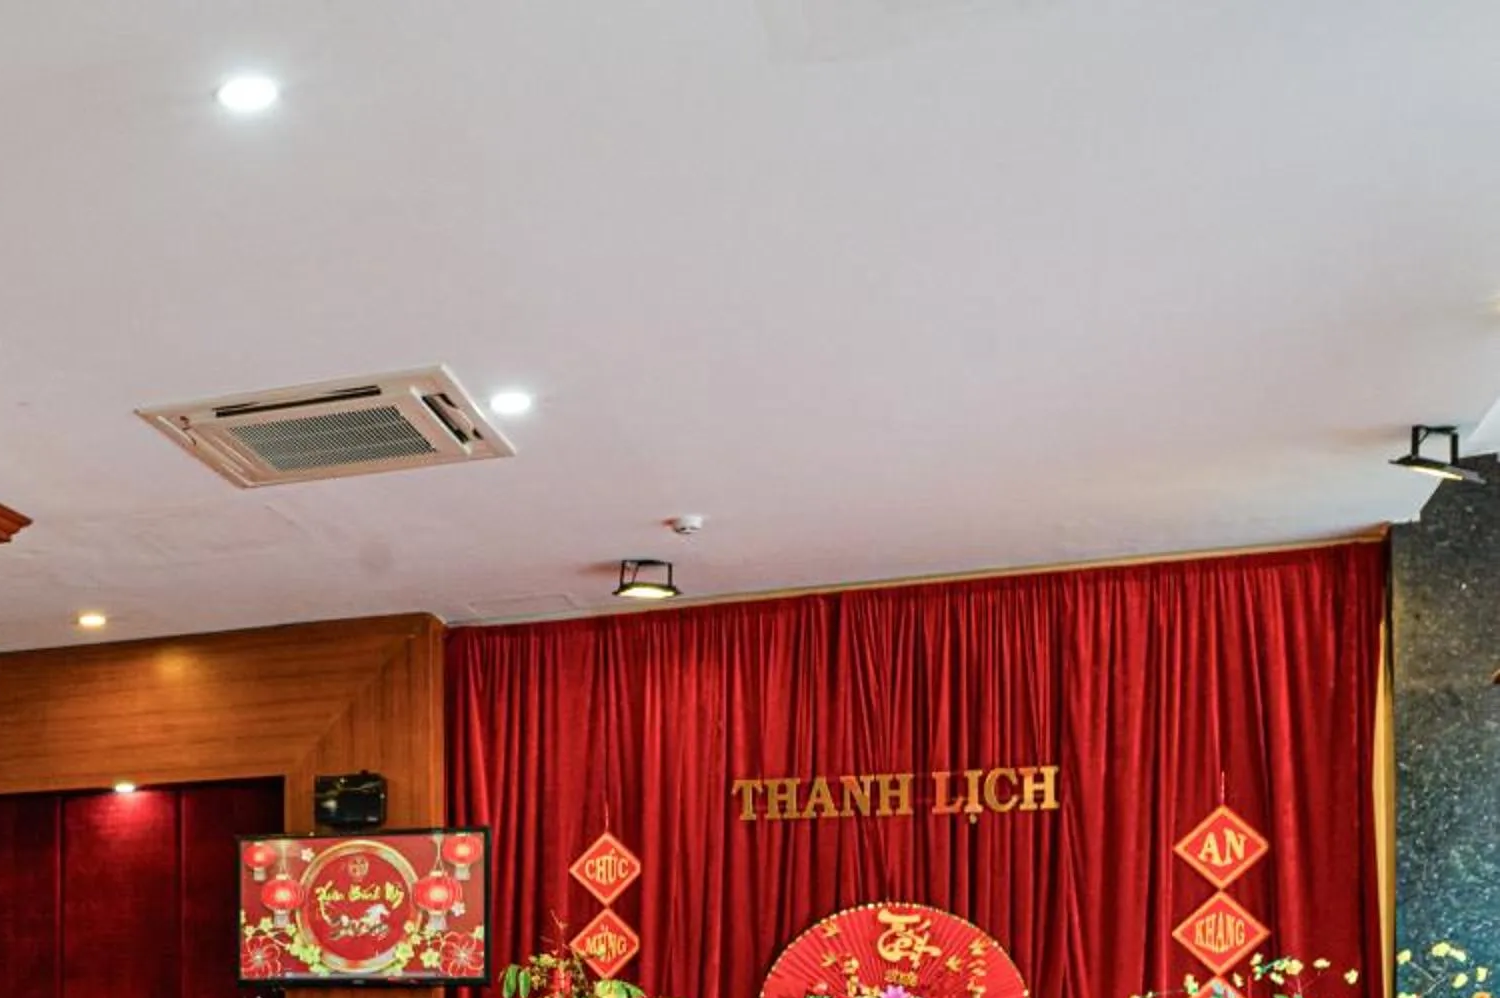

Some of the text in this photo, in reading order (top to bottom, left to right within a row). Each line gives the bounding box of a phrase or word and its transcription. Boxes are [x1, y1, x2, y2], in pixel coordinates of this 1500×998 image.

[732, 766, 1060, 824] THANH LỊCH
[584, 848, 629, 886] CHÚC
[1198, 828, 1247, 866] AN
[1194, 911, 1245, 954] KHANG
